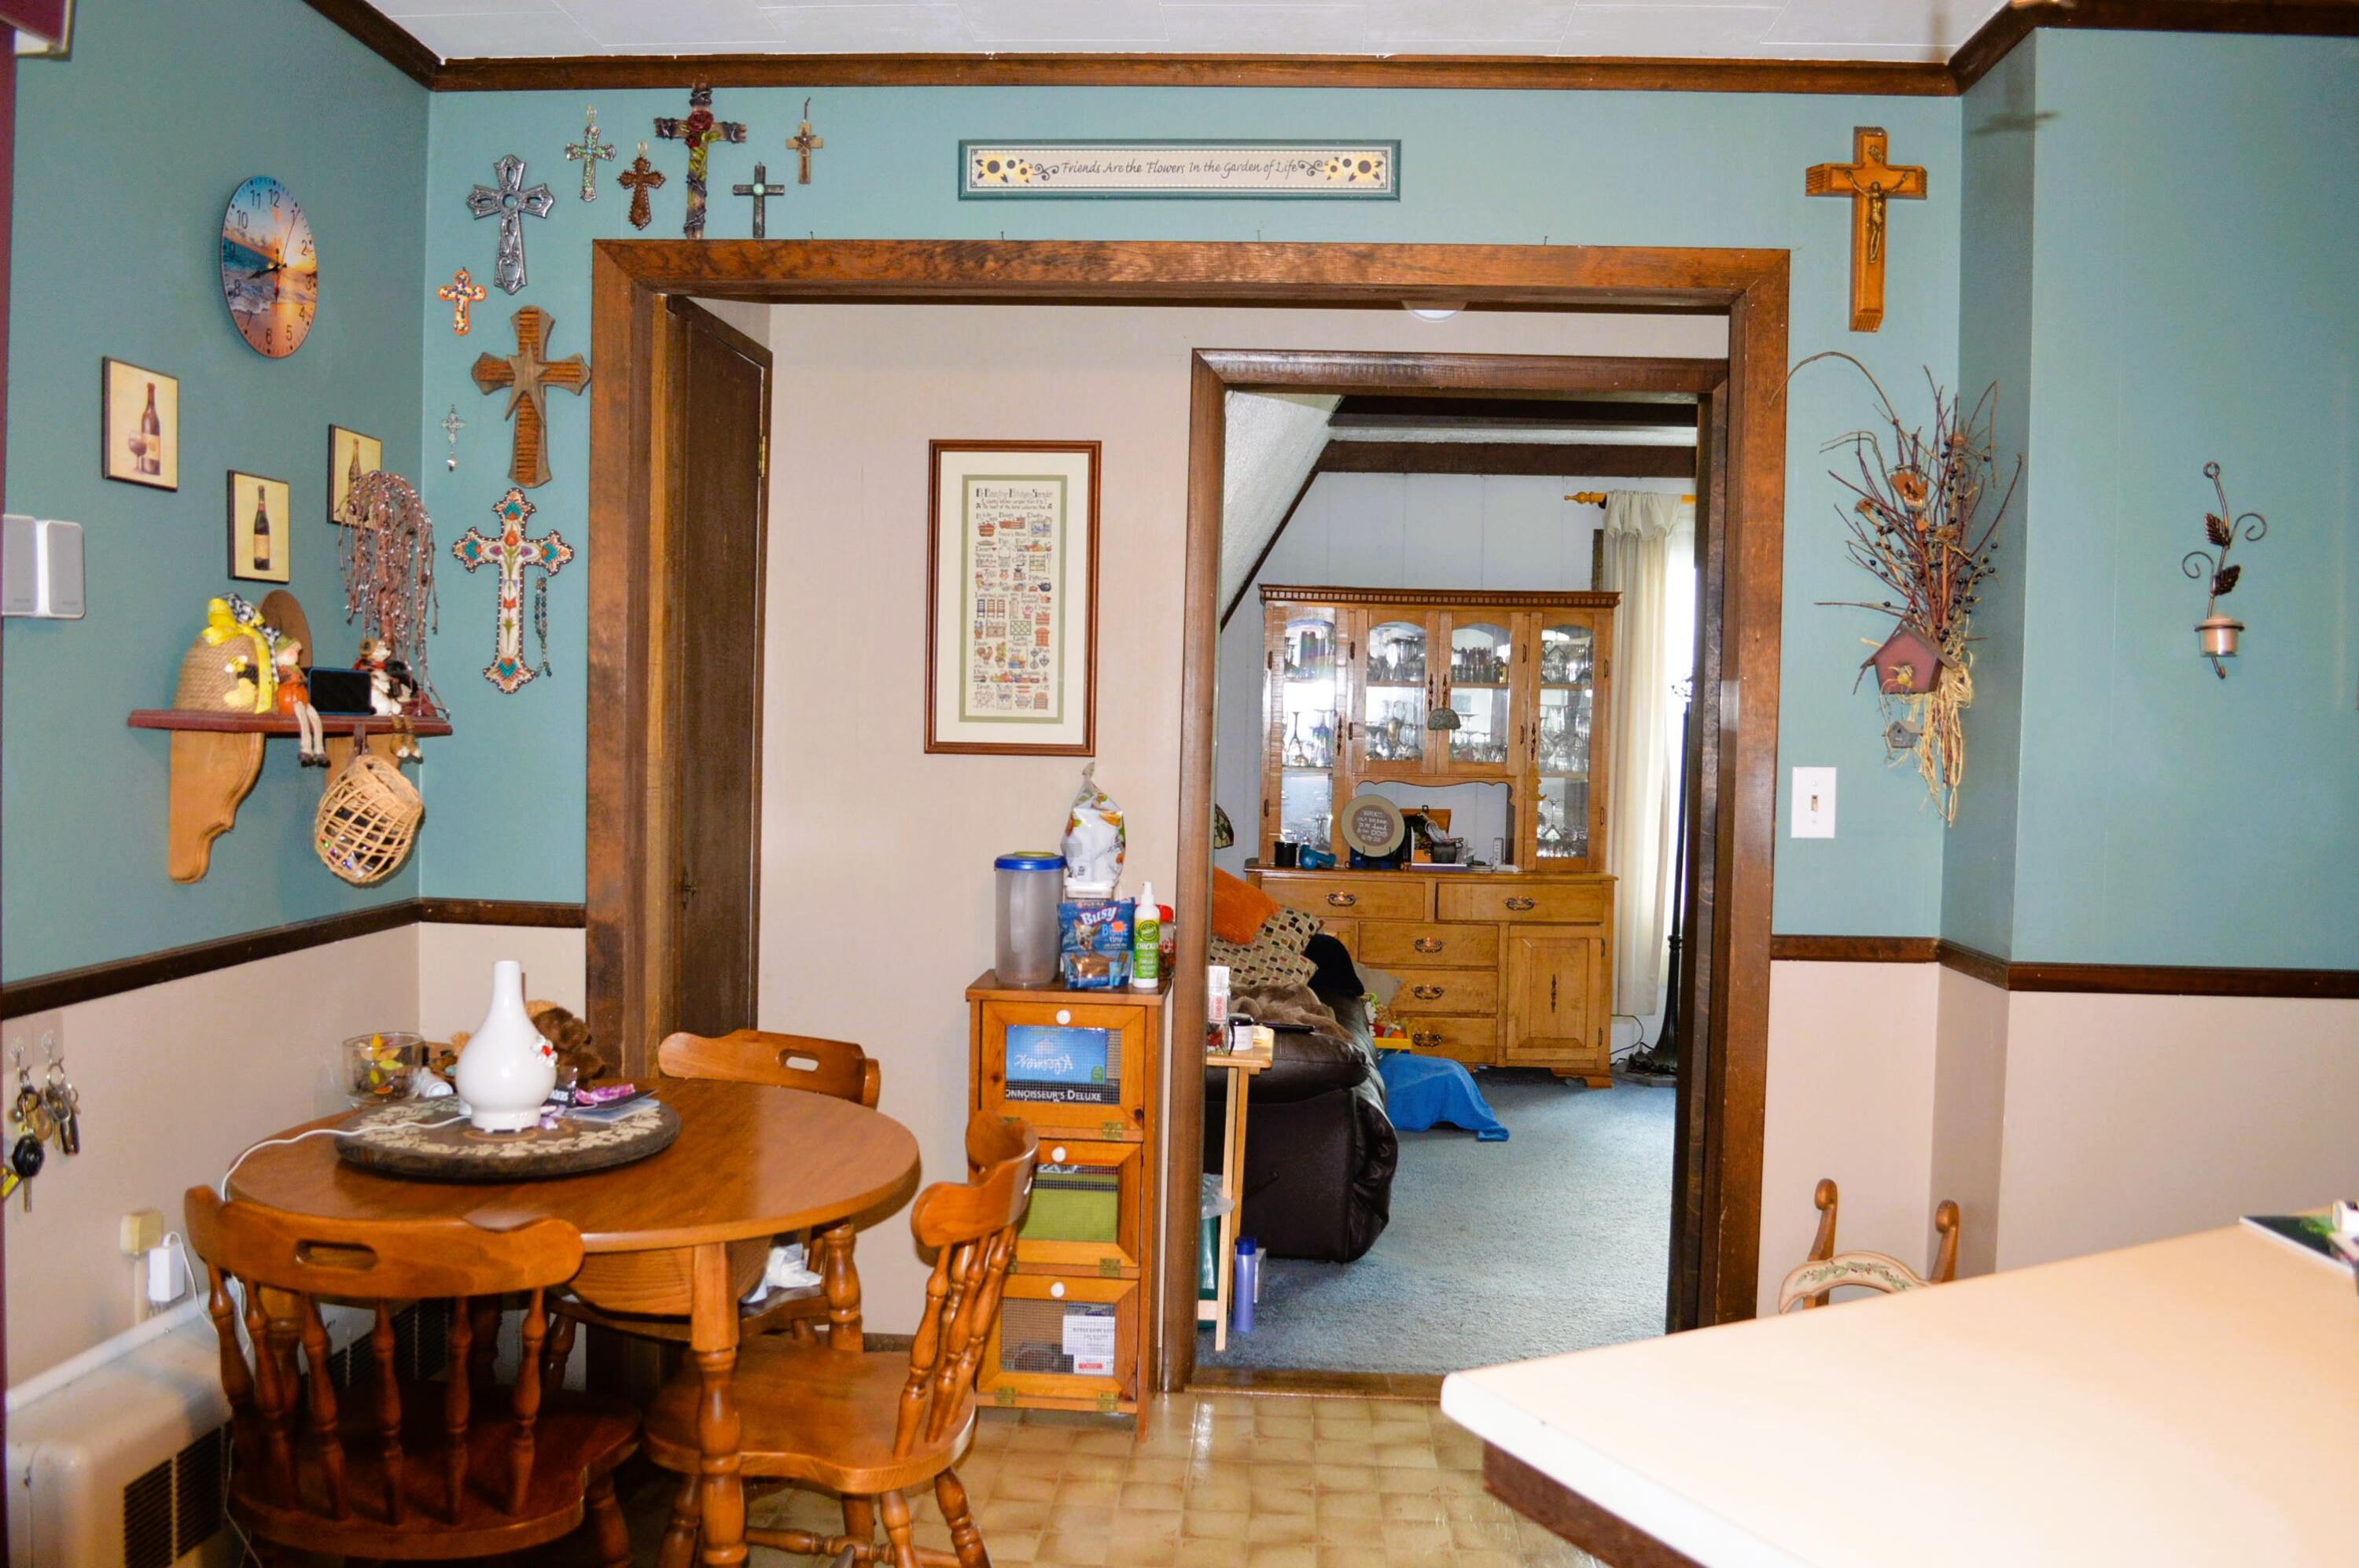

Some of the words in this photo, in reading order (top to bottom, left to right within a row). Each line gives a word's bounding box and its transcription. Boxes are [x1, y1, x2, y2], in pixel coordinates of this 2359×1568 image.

[1061, 159, 1101, 174] Friends
[1102, 160, 1125, 174] Are
[1125, 159, 1143, 174] the
[1146, 159, 1186, 174] Flowers
[1188, 160, 1200, 173] In
[1203, 159, 1220, 173] the
[1220, 160, 1262, 179] Garden
[1263, 159, 1275, 180] of
[1275, 159, 1298, 180] Life
[250, 190, 261, 209] 11
[268, 188, 280, 208] 12
[237, 209, 248, 229] 10
[1080, 906, 1117, 926] Busy
[1006, 1089, 1065, 1100] ONNOISSEUR'S
[1067, 1090, 1102, 1101] DELUXE
